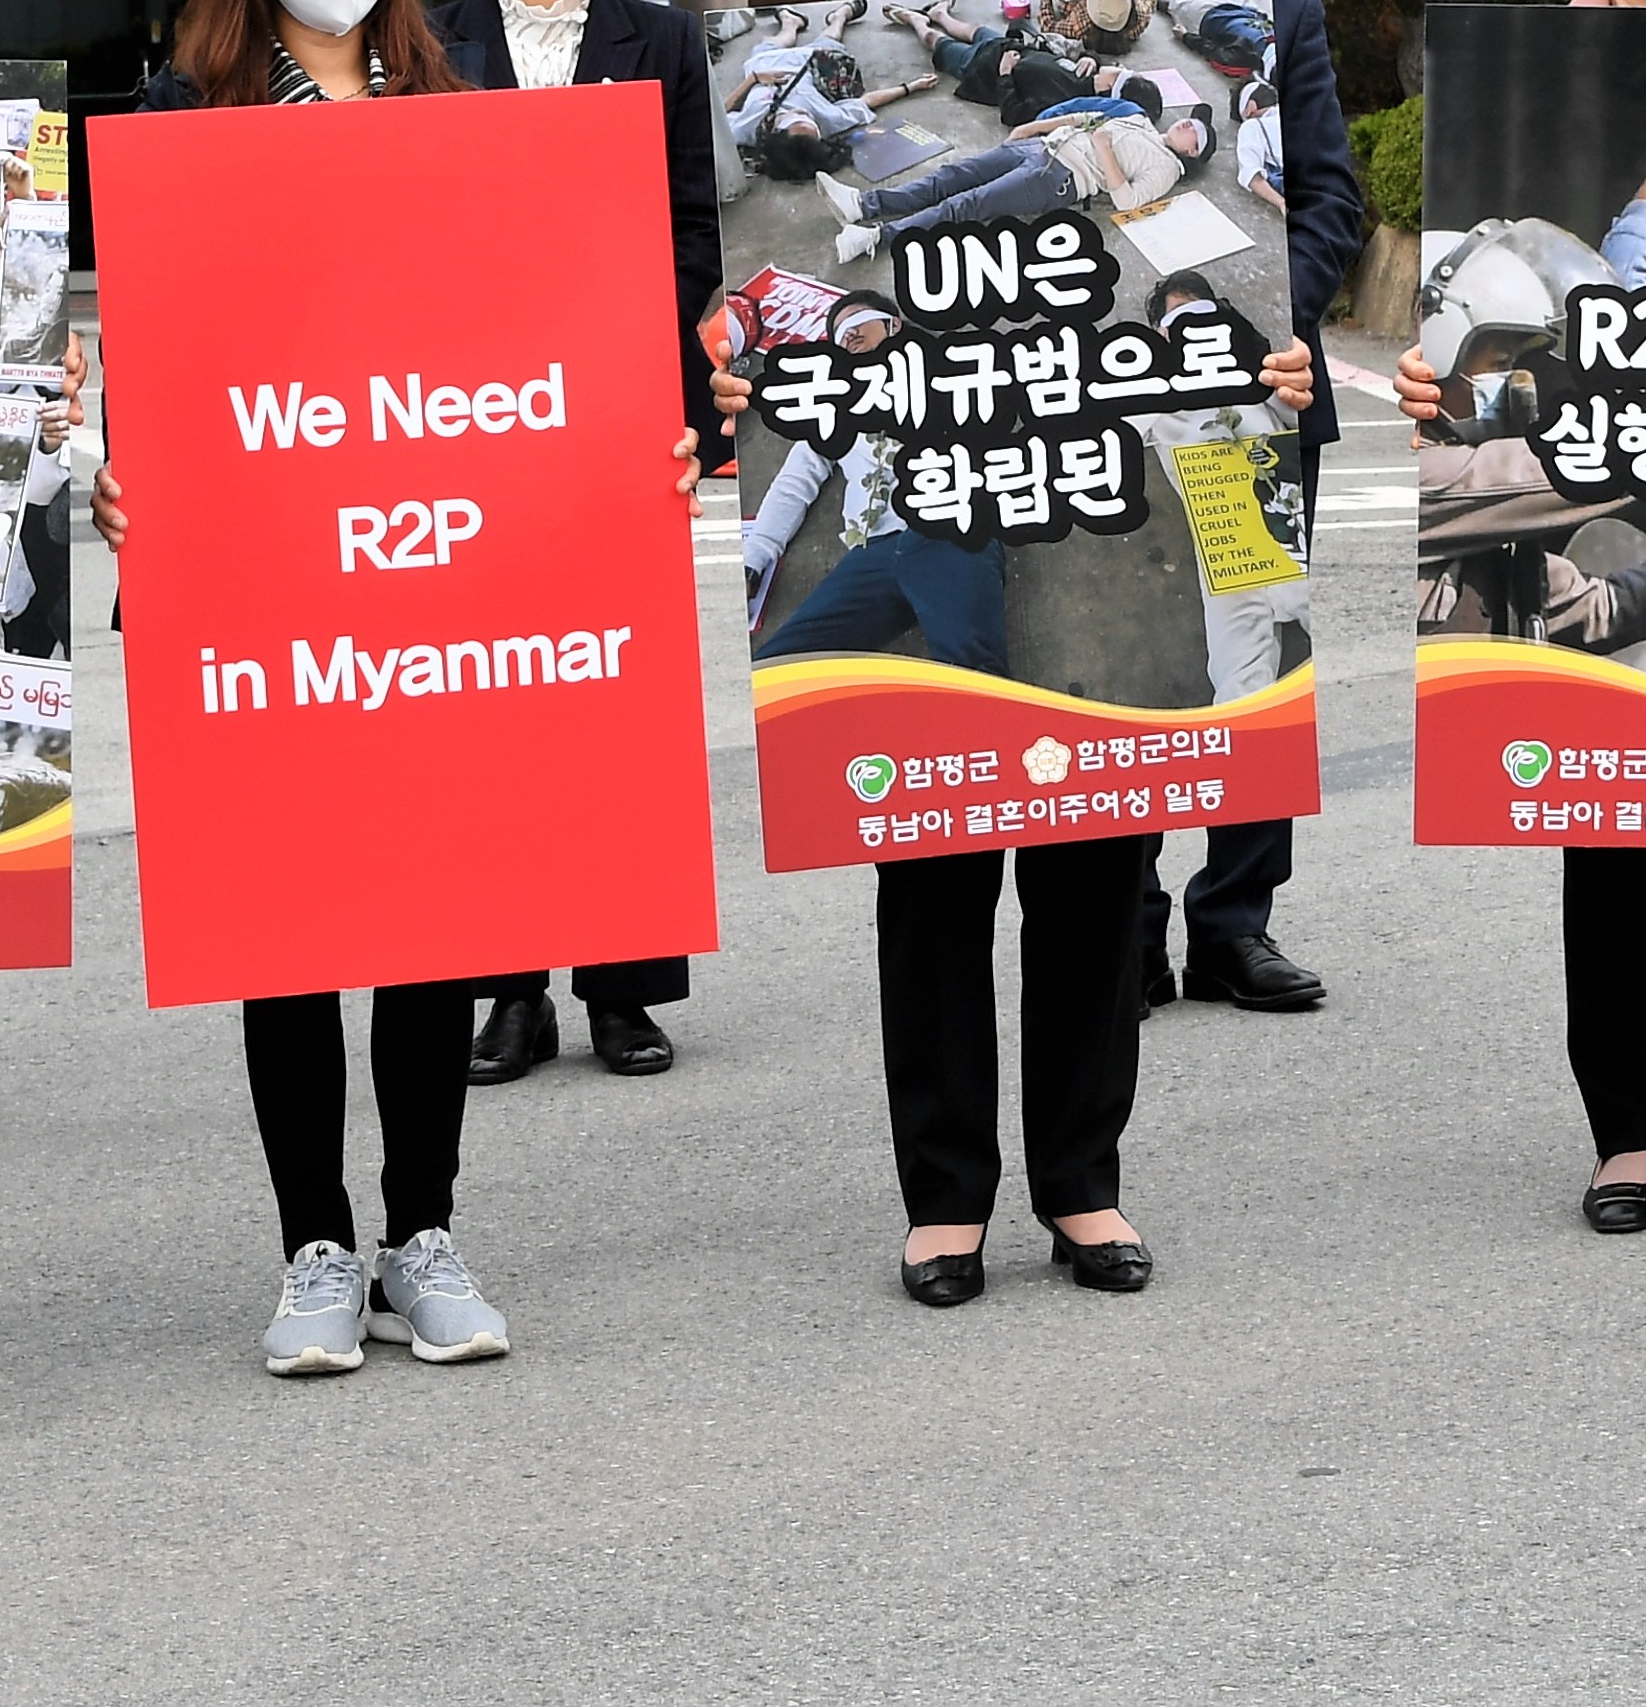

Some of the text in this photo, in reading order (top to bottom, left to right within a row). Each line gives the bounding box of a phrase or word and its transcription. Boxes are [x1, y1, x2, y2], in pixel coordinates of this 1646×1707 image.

[36, 124, 68, 146] ST
[905, 221, 1098, 313] UN은
[761, 323, 1252, 441] 국제규범으로
[227, 362, 567, 452] We Need
[1179, 447, 1234, 462] KIDS ARE
[905, 427, 1127, 534] 확립된
[1183, 462, 1222, 475] BEING
[1190, 490, 1226, 503] THEN
[1195, 501, 1247, 517] USED IN
[337, 498, 483, 573] R2P
[1200, 518, 1242, 532] CRUEL
[1204, 533, 1237, 548] JOBS
[1208, 547, 1255, 563] BY THE
[1213, 558, 1279, 579] MILITARY.
[200, 626, 632, 714] in Myanmar
[902, 726, 1231, 790] 함평군 함평군의회
[858, 779, 1225, 847] 동남아 결혼이주여성 일동
[1509, 801, 1604, 832] 동남아
